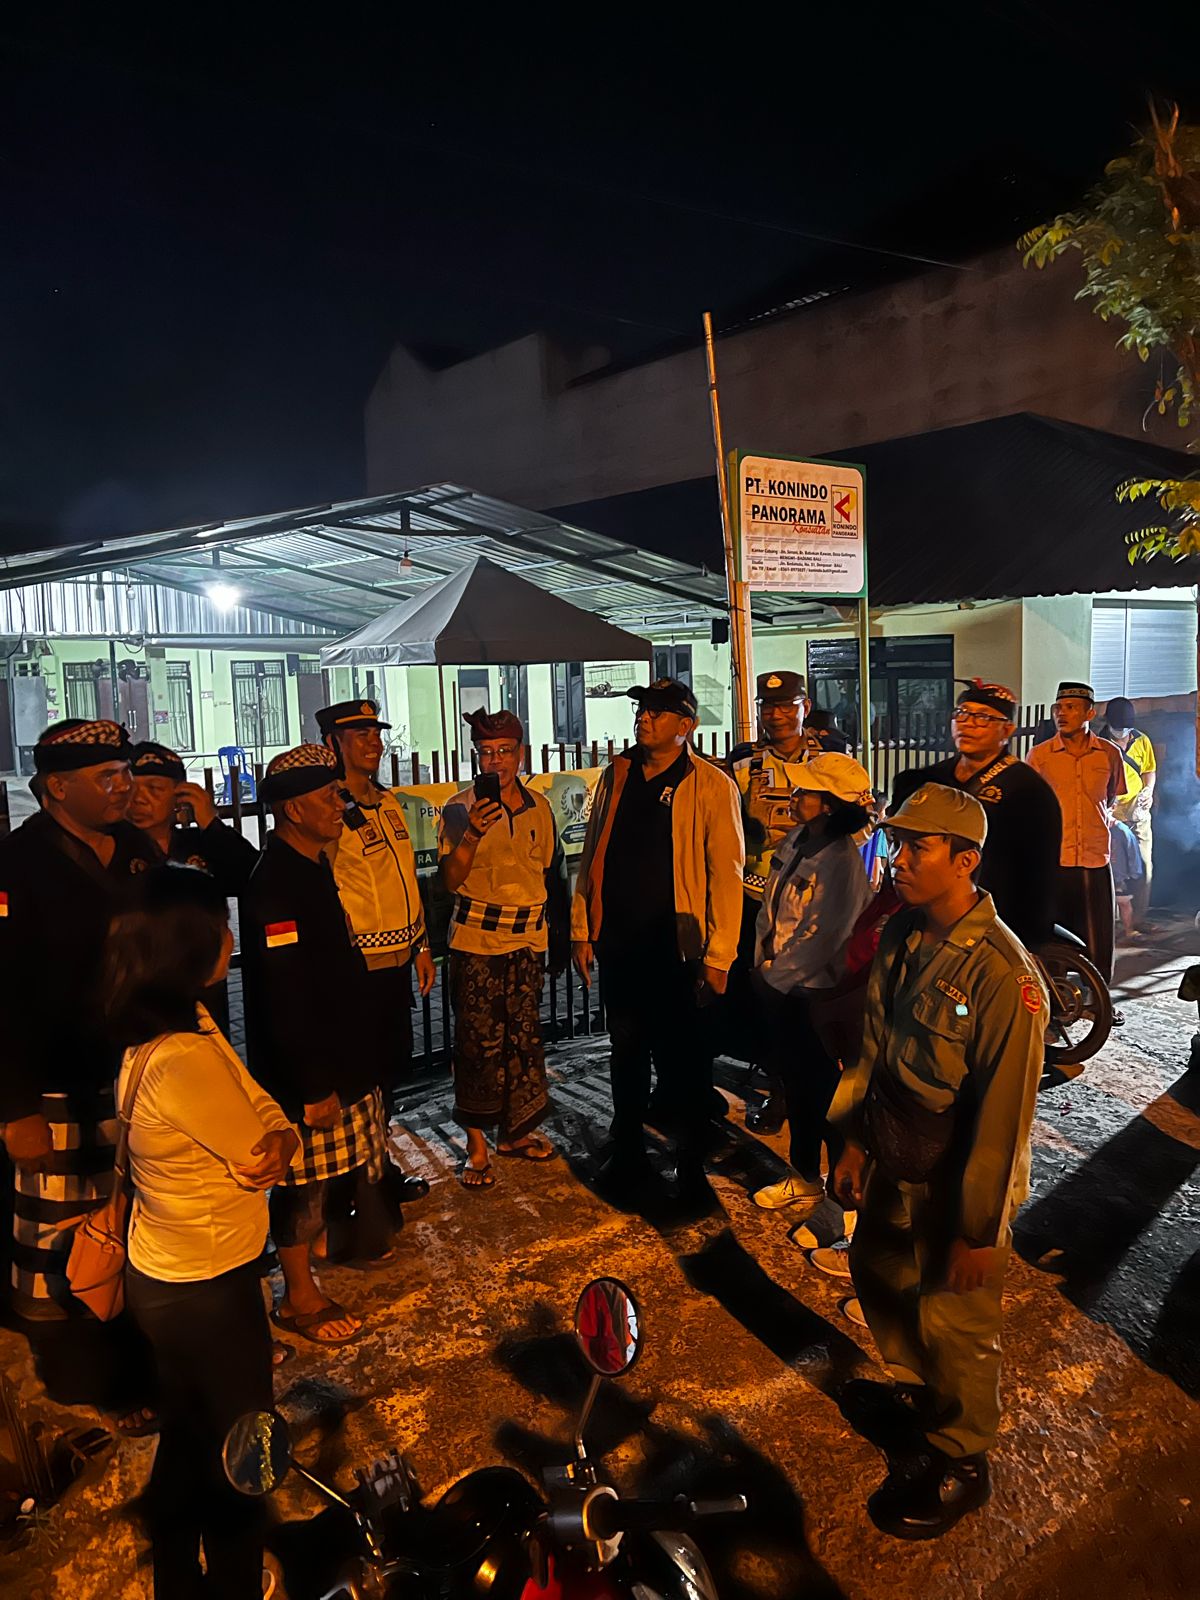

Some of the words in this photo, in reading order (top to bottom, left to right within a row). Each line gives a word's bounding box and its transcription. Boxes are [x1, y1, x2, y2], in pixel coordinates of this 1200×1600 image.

[745, 477, 764, 494] PT.
[768, 480, 828, 500] KONINDO
[751, 504, 826, 525] PANORAMA
[833, 523, 857, 531] KONINDO
[420, 806, 443, 818] PEN
